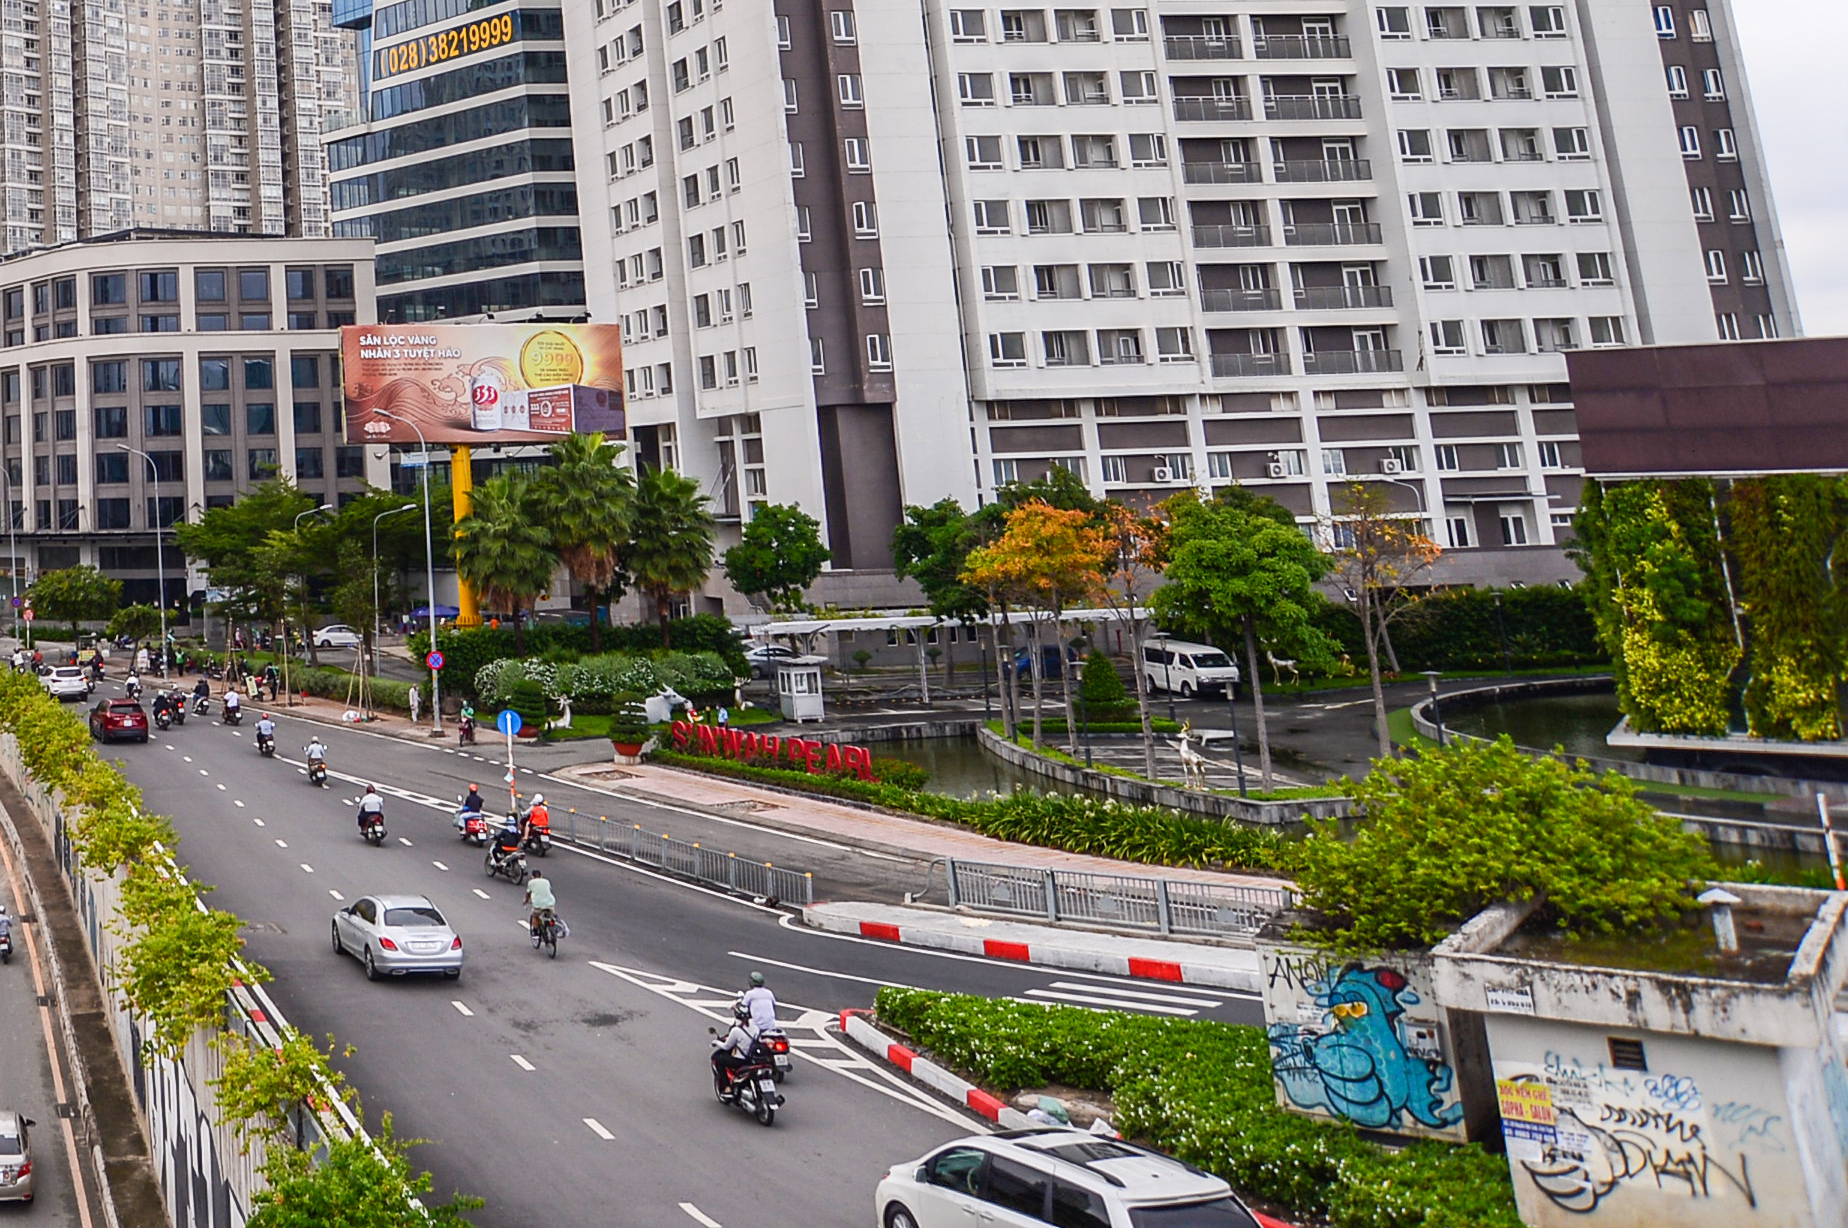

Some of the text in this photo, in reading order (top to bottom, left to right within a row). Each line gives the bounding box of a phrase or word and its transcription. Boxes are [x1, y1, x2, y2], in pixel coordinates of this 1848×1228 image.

[379, 14, 513, 78] (028)38219999
[383, 333, 406, 348] LỘC
[407, 333, 437, 346] VÀNG
[393, 349, 401, 359] 3
[402, 346, 436, 361] TUYỆT
[531, 351, 574, 367] 9999
[473, 385, 497, 404] 333
[786, 735, 881, 783] PEARL
